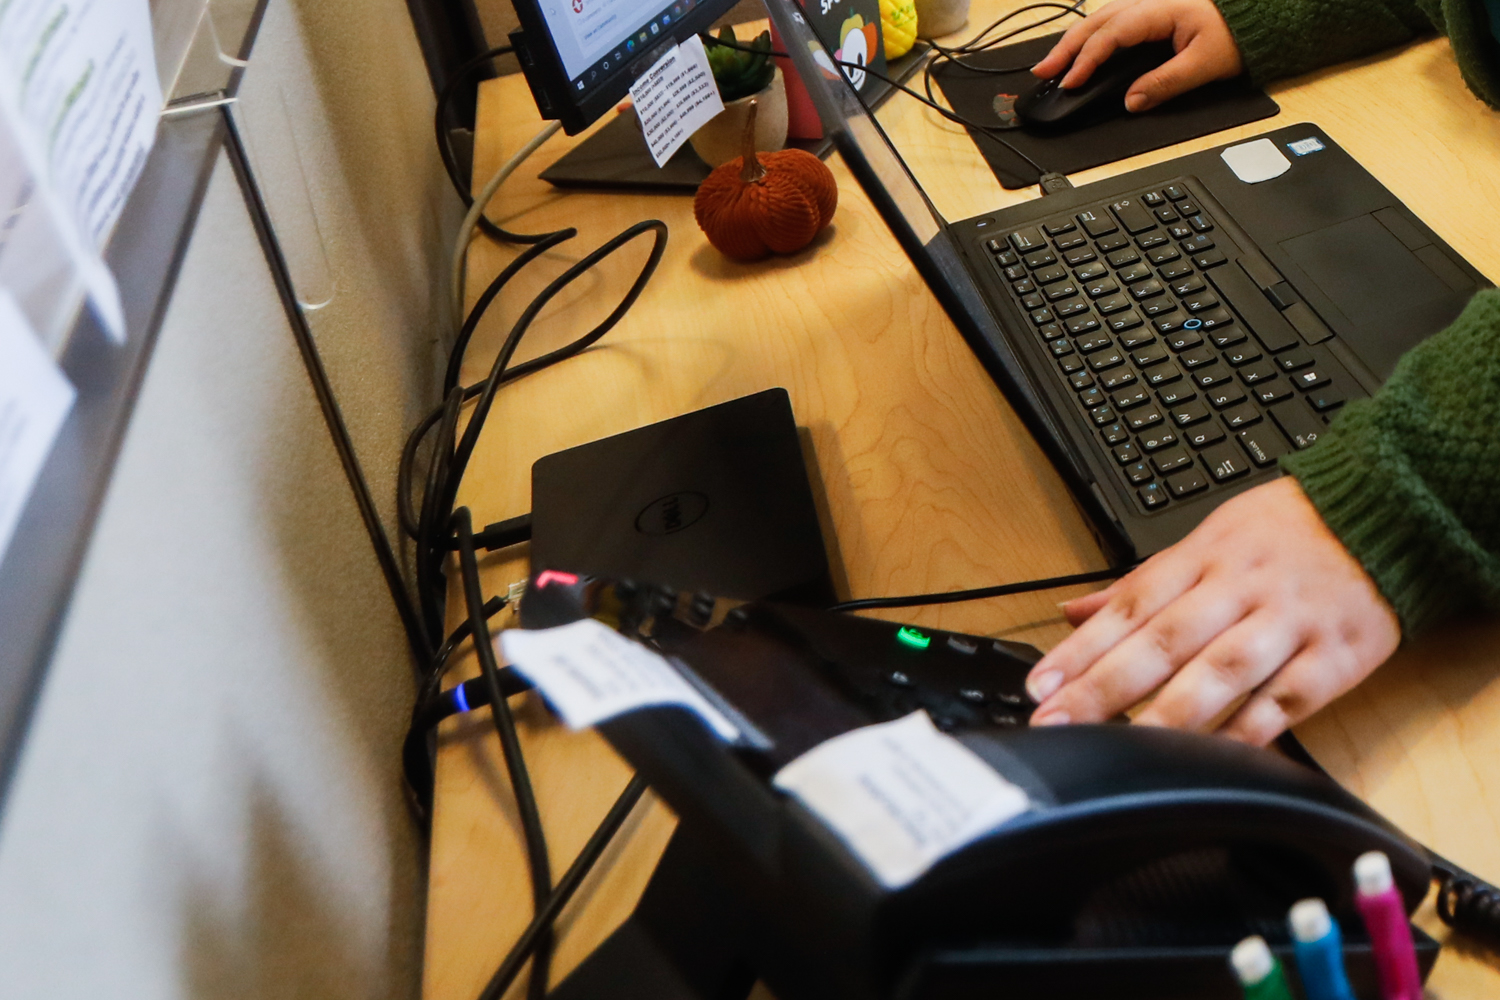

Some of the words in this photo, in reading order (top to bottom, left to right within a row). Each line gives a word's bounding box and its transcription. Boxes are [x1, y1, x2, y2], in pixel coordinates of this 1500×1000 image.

[632, 78, 650, 96] Income
[649, 56, 675, 80] Conversion
[1179, 414, 1190, 422] W
